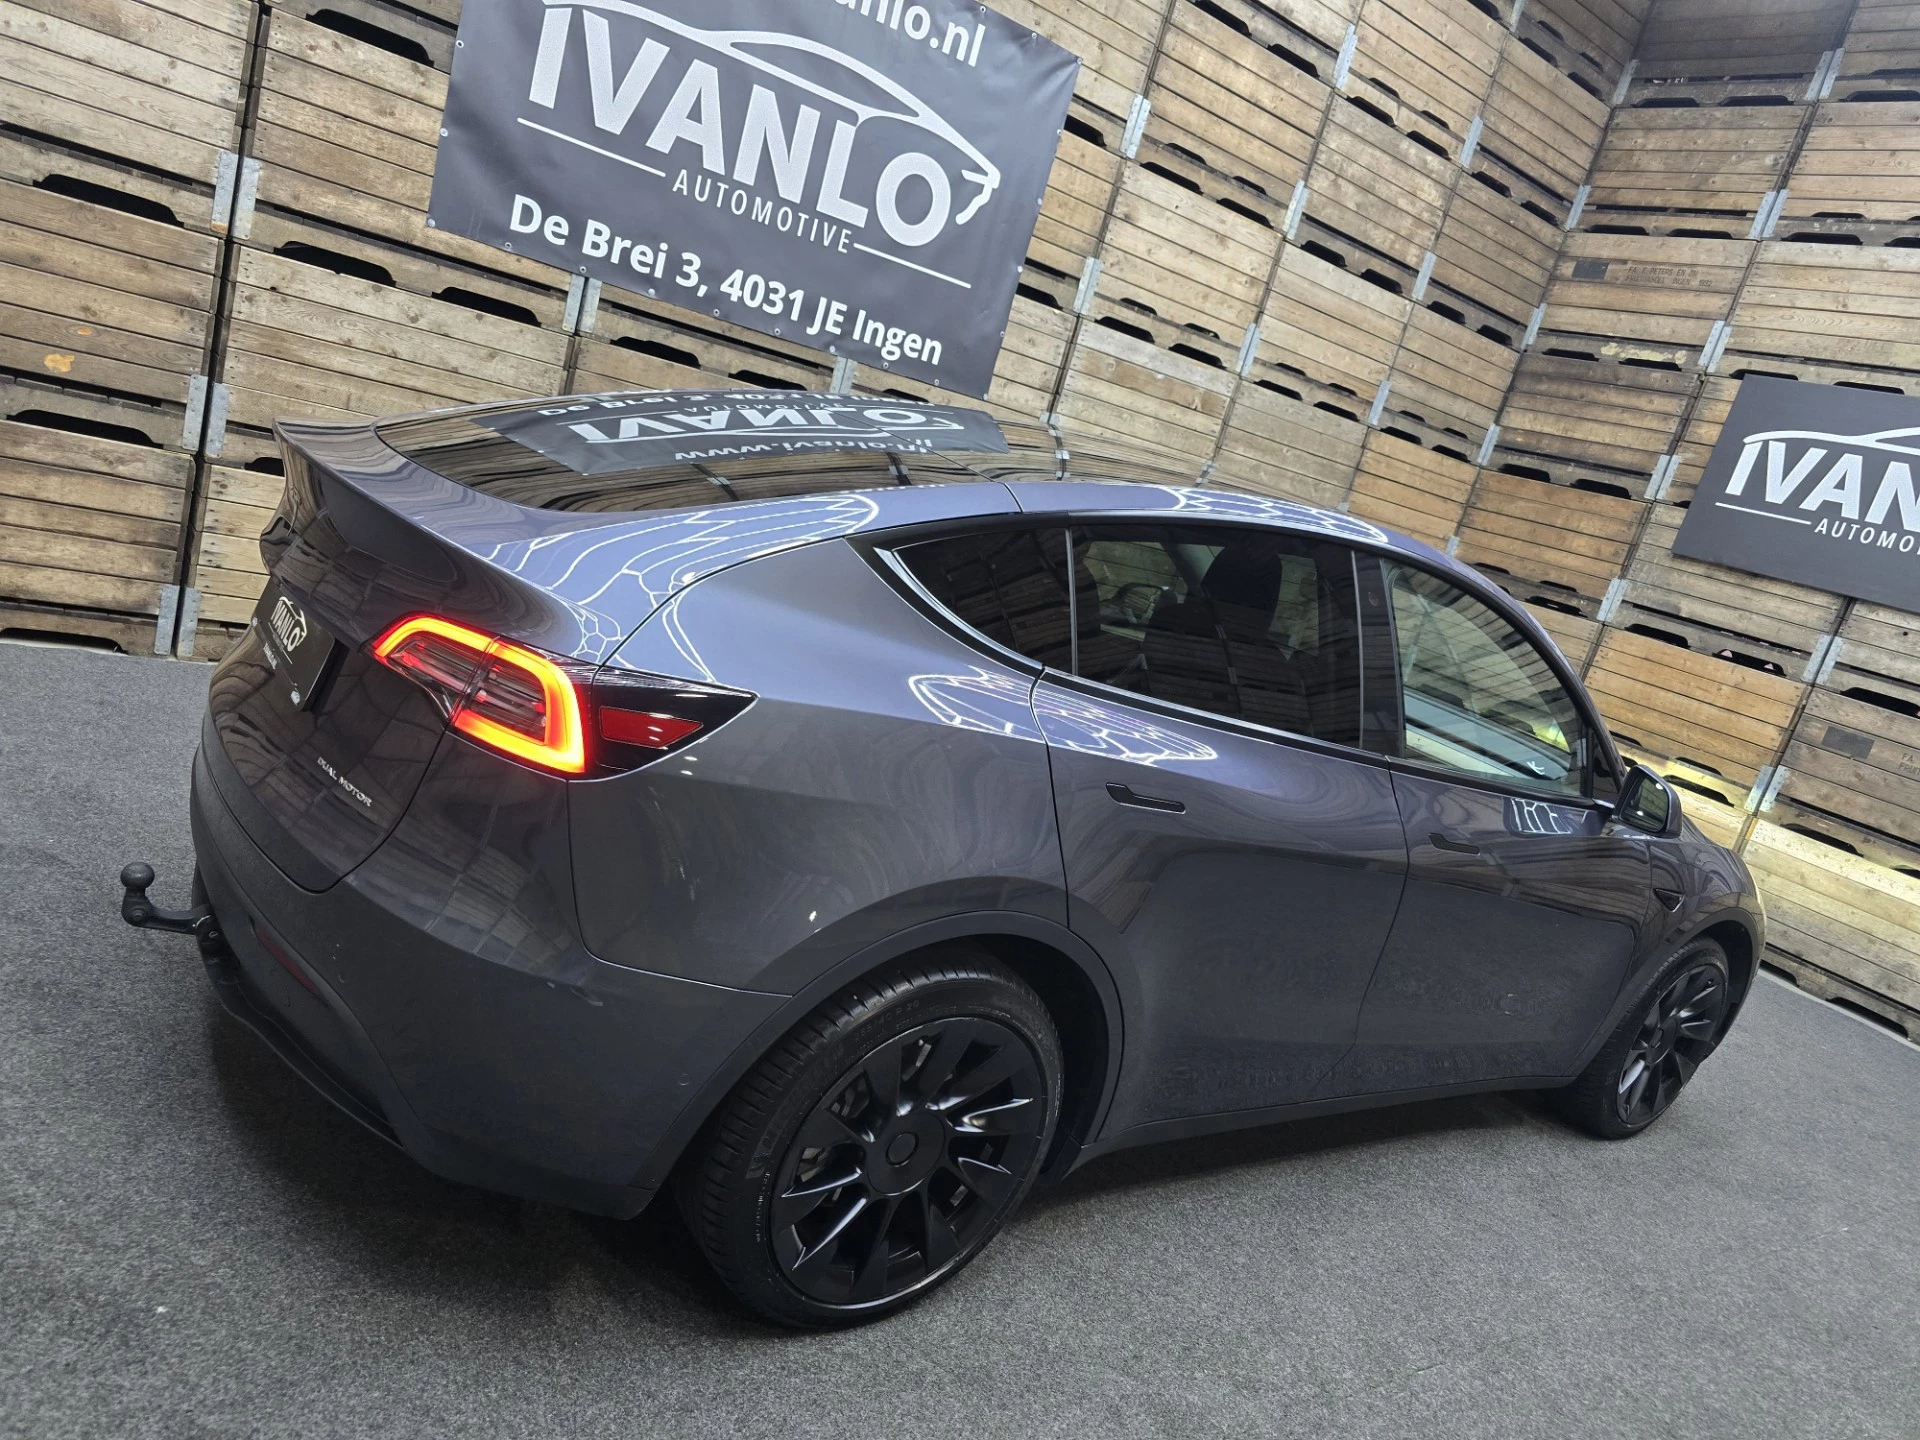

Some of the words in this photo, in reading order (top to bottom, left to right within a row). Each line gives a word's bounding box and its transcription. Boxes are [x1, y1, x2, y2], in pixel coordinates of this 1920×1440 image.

[528, 7, 951, 247] IVANLO
[672, 168, 853, 254] AUTOMOTIVE
[509, 193, 570, 247] De
[582, 219, 669, 279] Brei
[675, 252, 709, 297] 3,
[720, 268, 805, 322] 4031
[807, 297, 846, 337] JE
[853, 309, 942, 366] Ingen
[1814, 518, 1920, 556] AUTOMO
[271, 600, 301, 652] IVANLO
[317, 756, 337, 780] DUAL
[339, 776, 373, 807] MOTOR
